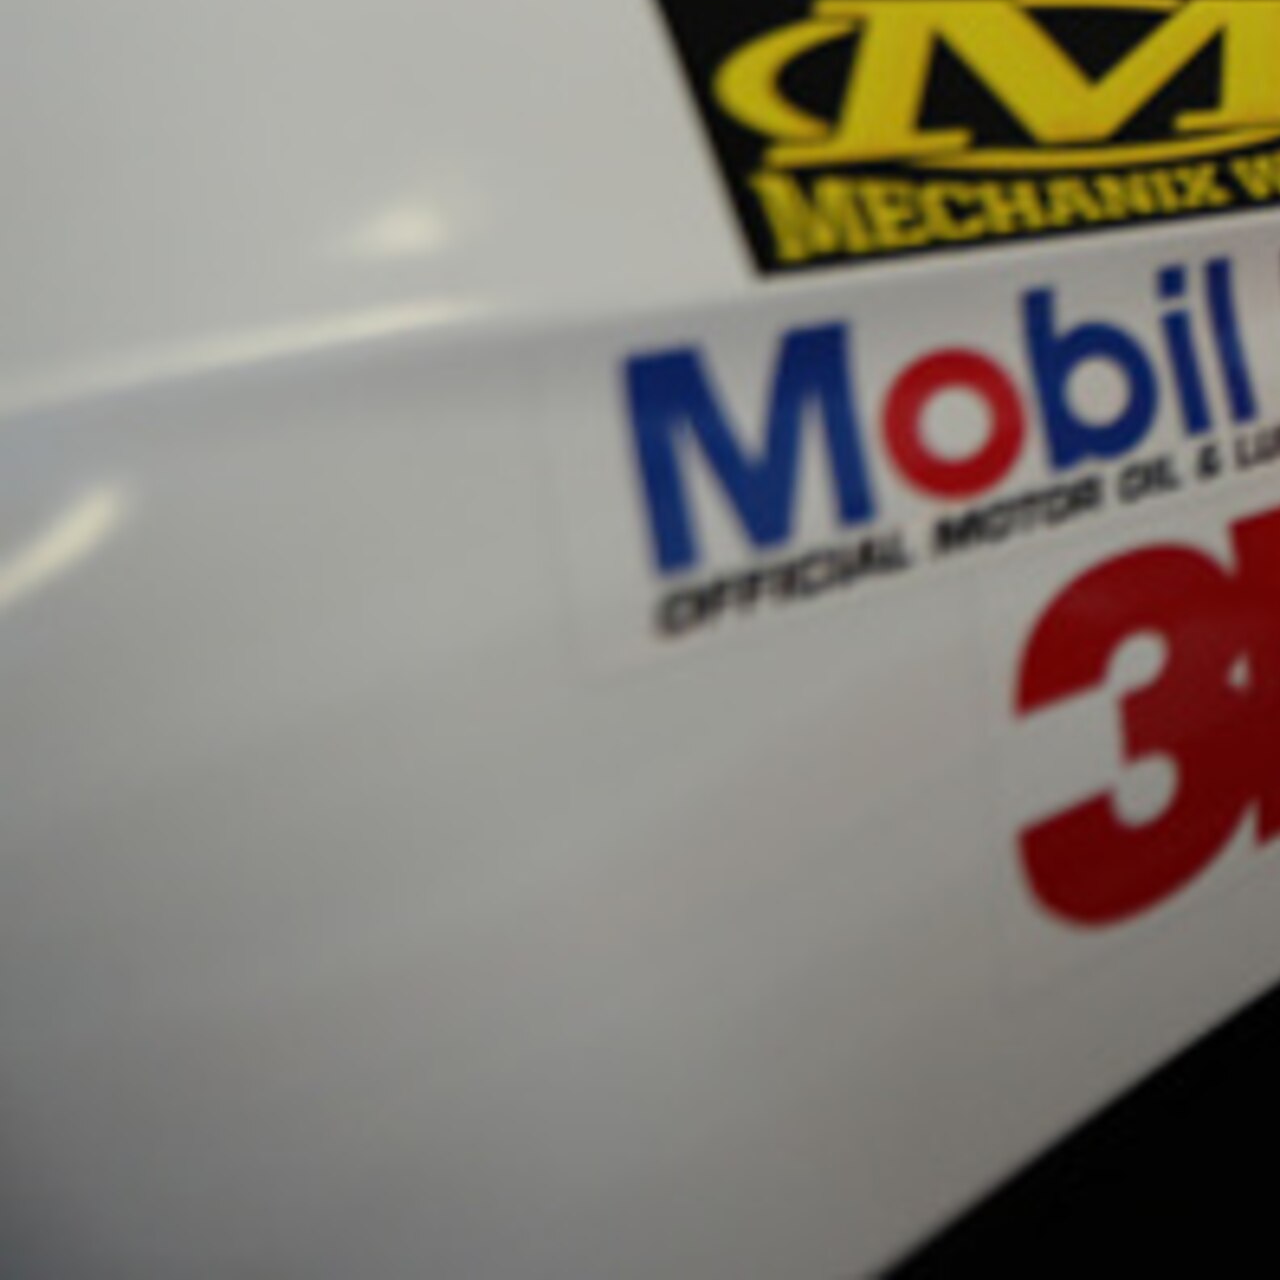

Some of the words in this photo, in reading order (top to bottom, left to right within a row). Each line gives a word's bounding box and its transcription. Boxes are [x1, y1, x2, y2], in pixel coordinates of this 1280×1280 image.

[747, 162, 1226, 264] MECHANIX
[624, 257, 1258, 580] Mobil
[655, 530, 911, 638] OFFICIAL
[931, 472, 1106, 556] MOTOR
[1118, 451, 1181, 502] OIL
[1195, 442, 1223, 481] &
